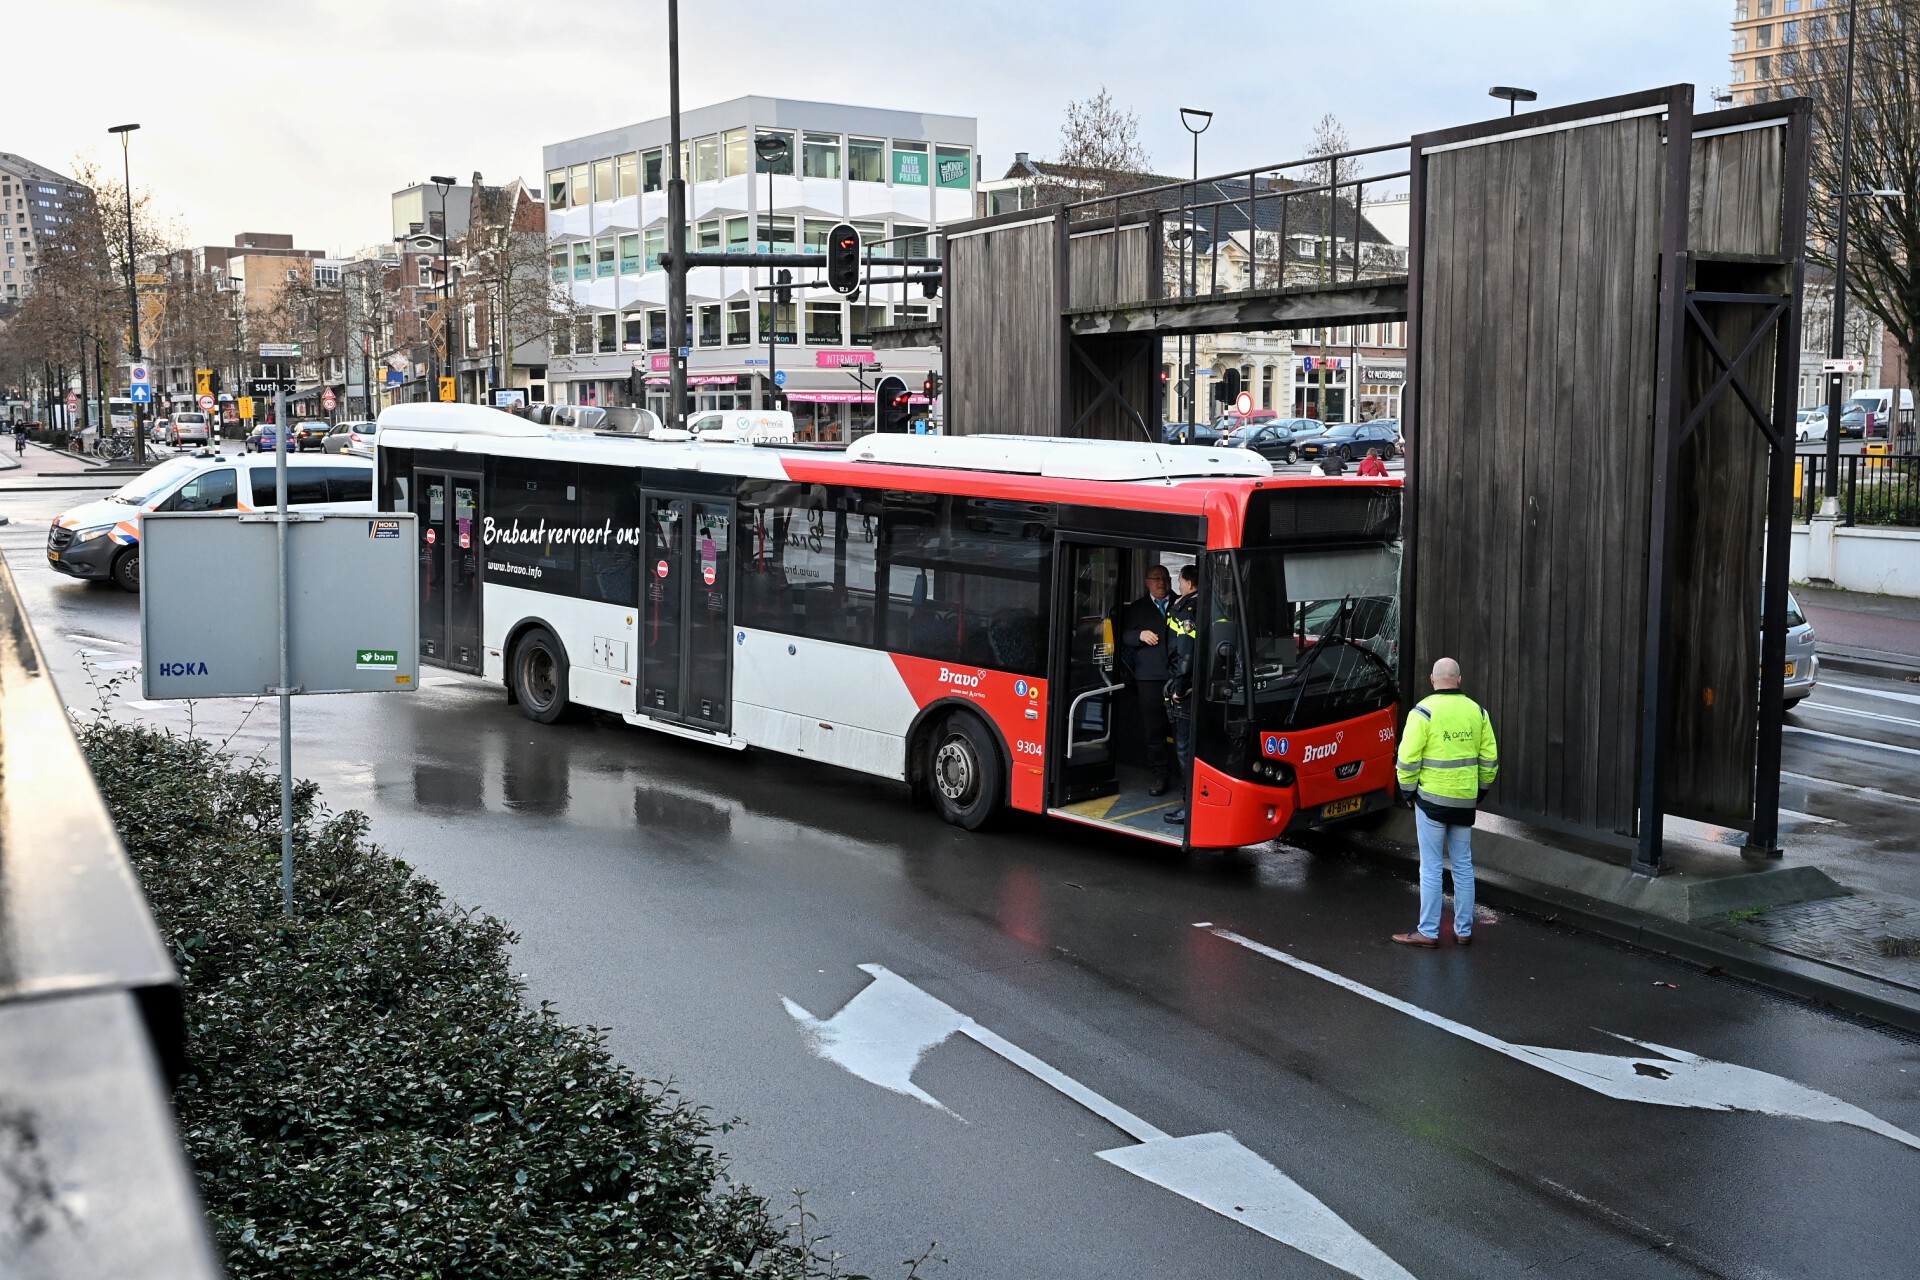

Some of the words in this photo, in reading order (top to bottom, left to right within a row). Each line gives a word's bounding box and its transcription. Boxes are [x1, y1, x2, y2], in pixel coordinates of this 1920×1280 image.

[902, 155, 918, 165] OVER
[901, 164, 920, 174] ALLES
[899, 173, 922, 183] PRATEN
[761, 334, 790, 343] wrkon
[483, 516, 546, 545] Brabant
[547, 517, 612, 545] vervoert
[616, 527, 641, 546] ons
[487, 561, 542, 578] www.bravo.info
[373, 652, 394, 661] bam
[160, 662, 209, 677] HOKA
[938, 667, 979, 688] Bravo
[1378, 726, 1395, 742] 9304
[1016, 740, 1043, 757] 9304
[1302, 741, 1338, 764] Bravo
